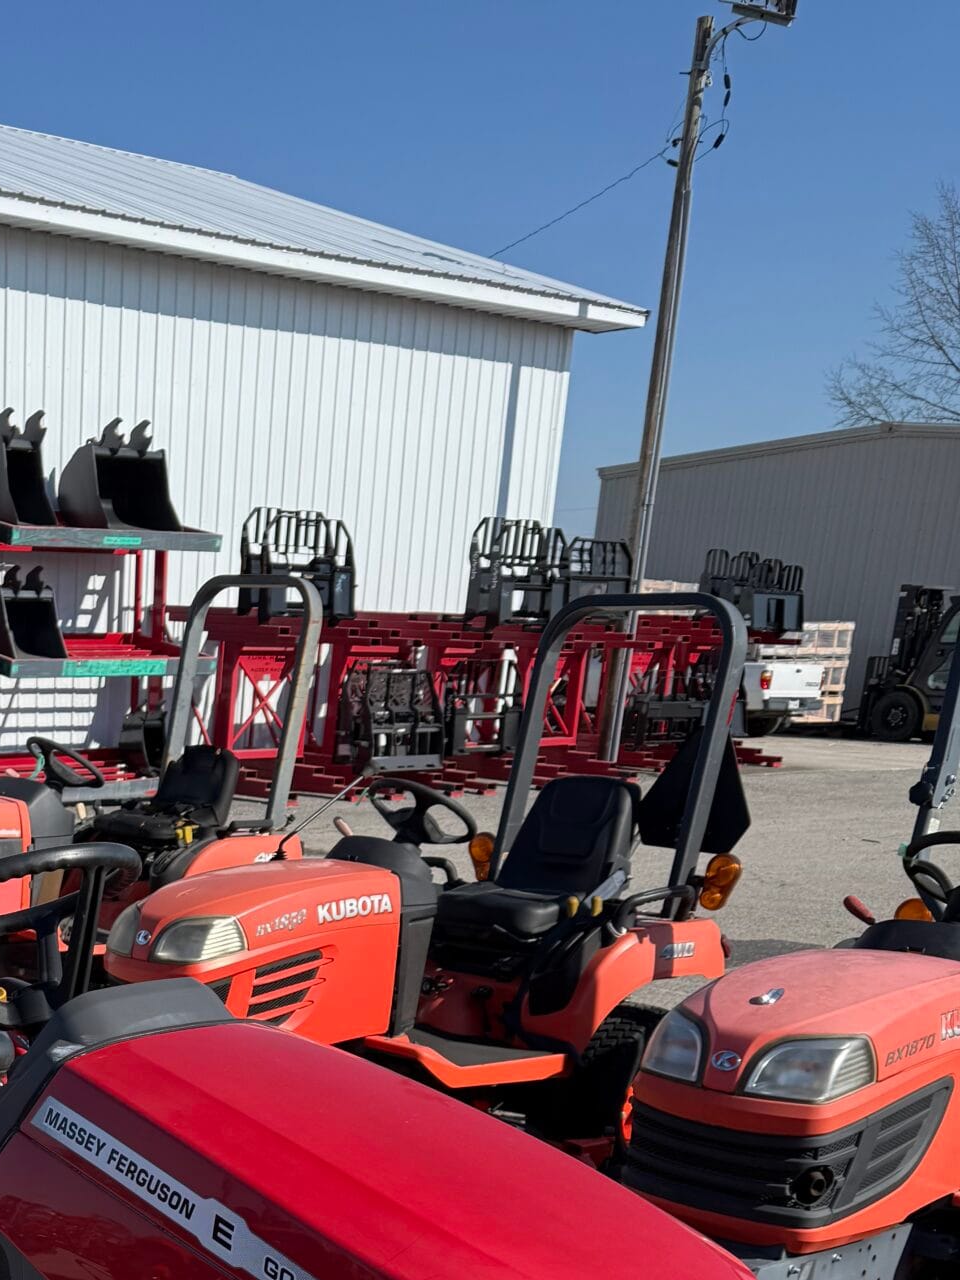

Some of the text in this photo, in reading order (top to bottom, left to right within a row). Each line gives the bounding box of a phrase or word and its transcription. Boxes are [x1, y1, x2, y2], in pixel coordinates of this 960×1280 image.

[316, 893, 393, 925] KUBOTA
[661, 941, 696, 960] 4WD
[884, 1032, 936, 1068] BX1870
[44, 1107, 107, 1157] MASSEY
[106, 1148, 196, 1221] FERGUSON
[211, 1213, 236, 1252] E
